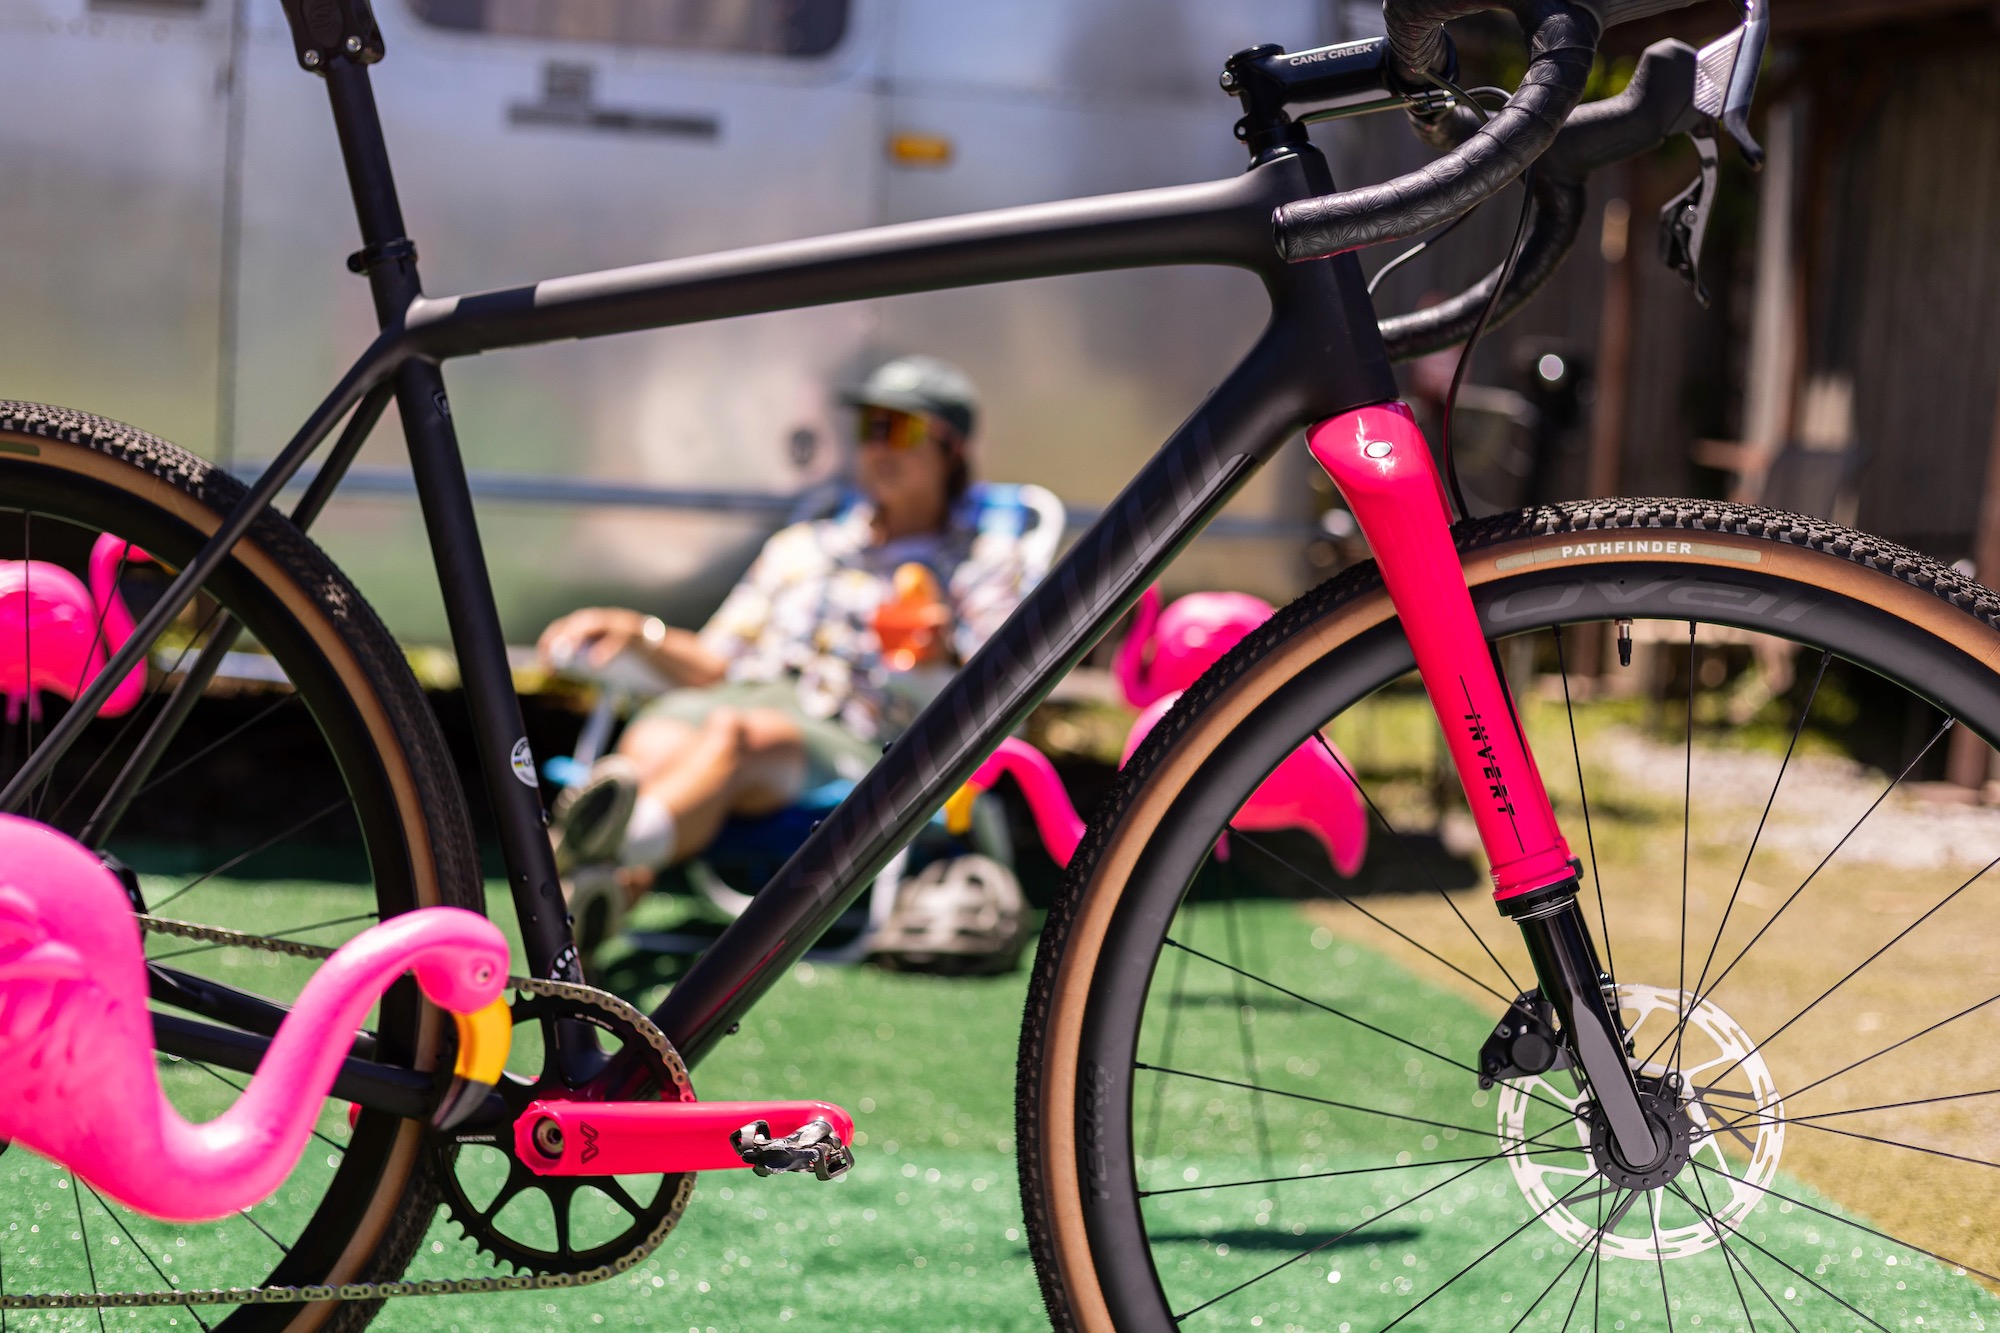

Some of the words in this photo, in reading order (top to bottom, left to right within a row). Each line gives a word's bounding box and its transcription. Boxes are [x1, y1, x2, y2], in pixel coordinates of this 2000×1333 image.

[1290, 53, 1327, 66] CANE
[1328, 44, 1372, 59] CREEK
[1561, 541, 1691, 558] PATHFINDER
[1487, 575, 1821, 622] oval
[1464, 714, 1516, 815] INVERT
